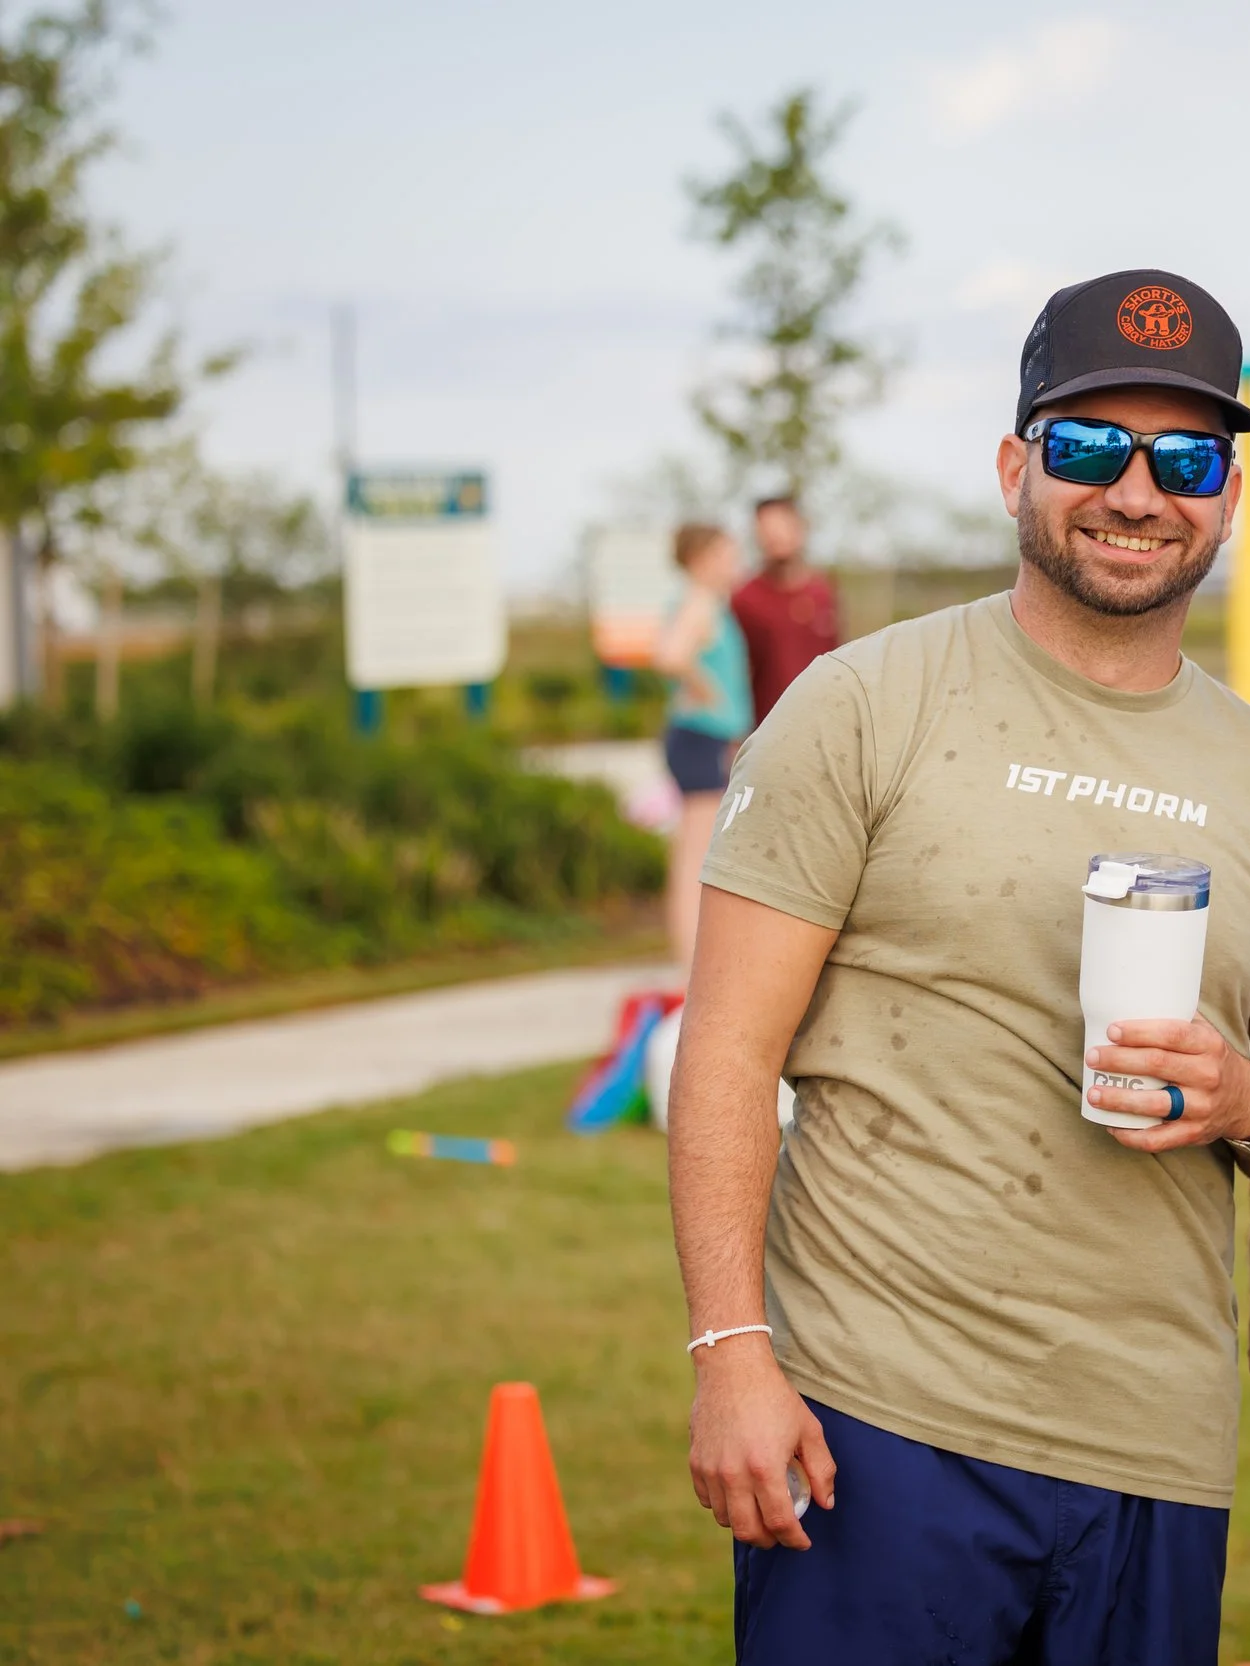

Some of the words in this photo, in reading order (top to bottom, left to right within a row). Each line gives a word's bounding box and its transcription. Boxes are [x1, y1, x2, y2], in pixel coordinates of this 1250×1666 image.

[1124, 289, 1187, 314] SHORTY'S
[1150, 321, 1189, 348] HATTERY
[1005, 763, 1068, 797] 1ST
[1066, 774, 1208, 828] PHORM
